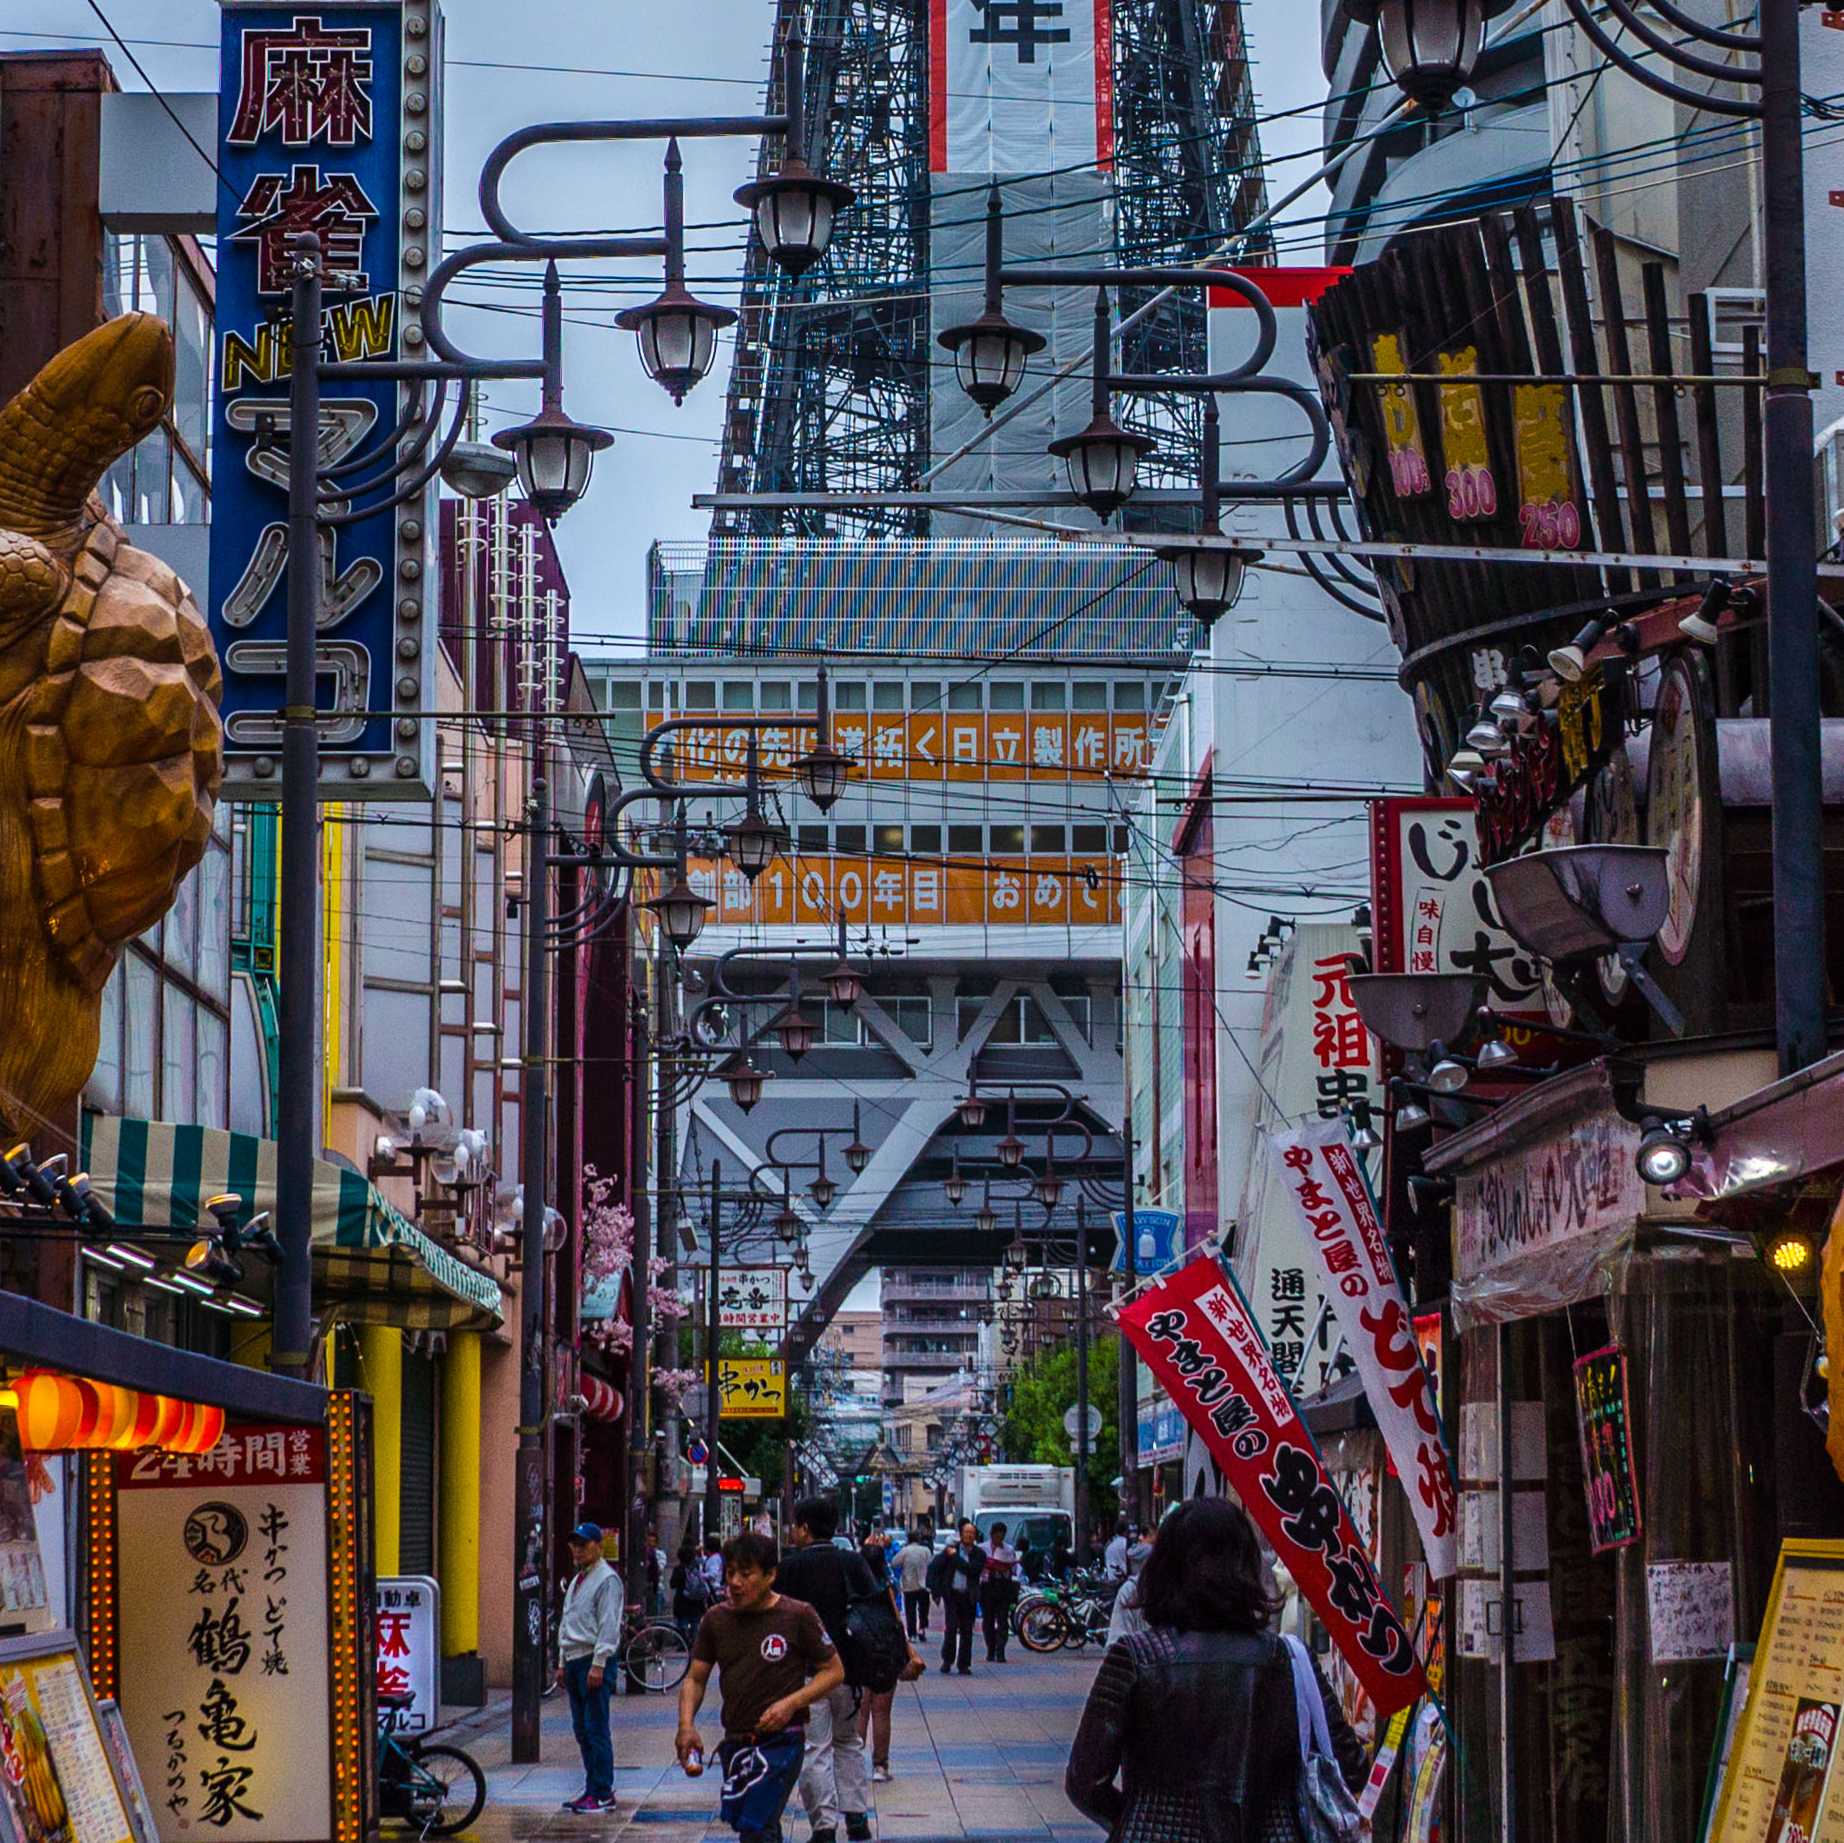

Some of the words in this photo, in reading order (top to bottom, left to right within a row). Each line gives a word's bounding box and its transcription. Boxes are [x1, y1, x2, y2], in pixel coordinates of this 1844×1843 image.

[226, 16, 380, 295] 麻雀
[1445, 467, 1498, 519] 300
[1519, 500, 1581, 550] 250
[222, 398, 384, 745] マルコ
[992, 872, 1125, 909] おめで
[1411, 898, 1440, 973] 味自慢
[1282, 1143, 1370, 1298] やまと屋の
[1325, 1145, 1395, 1284] 新世界名物
[738, 1272, 771, 1286] 串かつ
[719, 1312, 781, 1324] 時間営業中
[719, 1361, 782, 1405] 串かつ
[1205, 1290, 1294, 1423] 新世界名物
[130, 1431, 287, 1482] 24時間
[289, 1429, 313, 1477] 営業
[1144, 1308, 1271, 1460] やまと屋の
[1258, 1440, 1415, 1677] 串かつ
[257, 1501, 290, 1585] 串かつ
[187, 1567, 248, 1596] 名代
[186, 1596, 265, 1829] 鶴亀家
